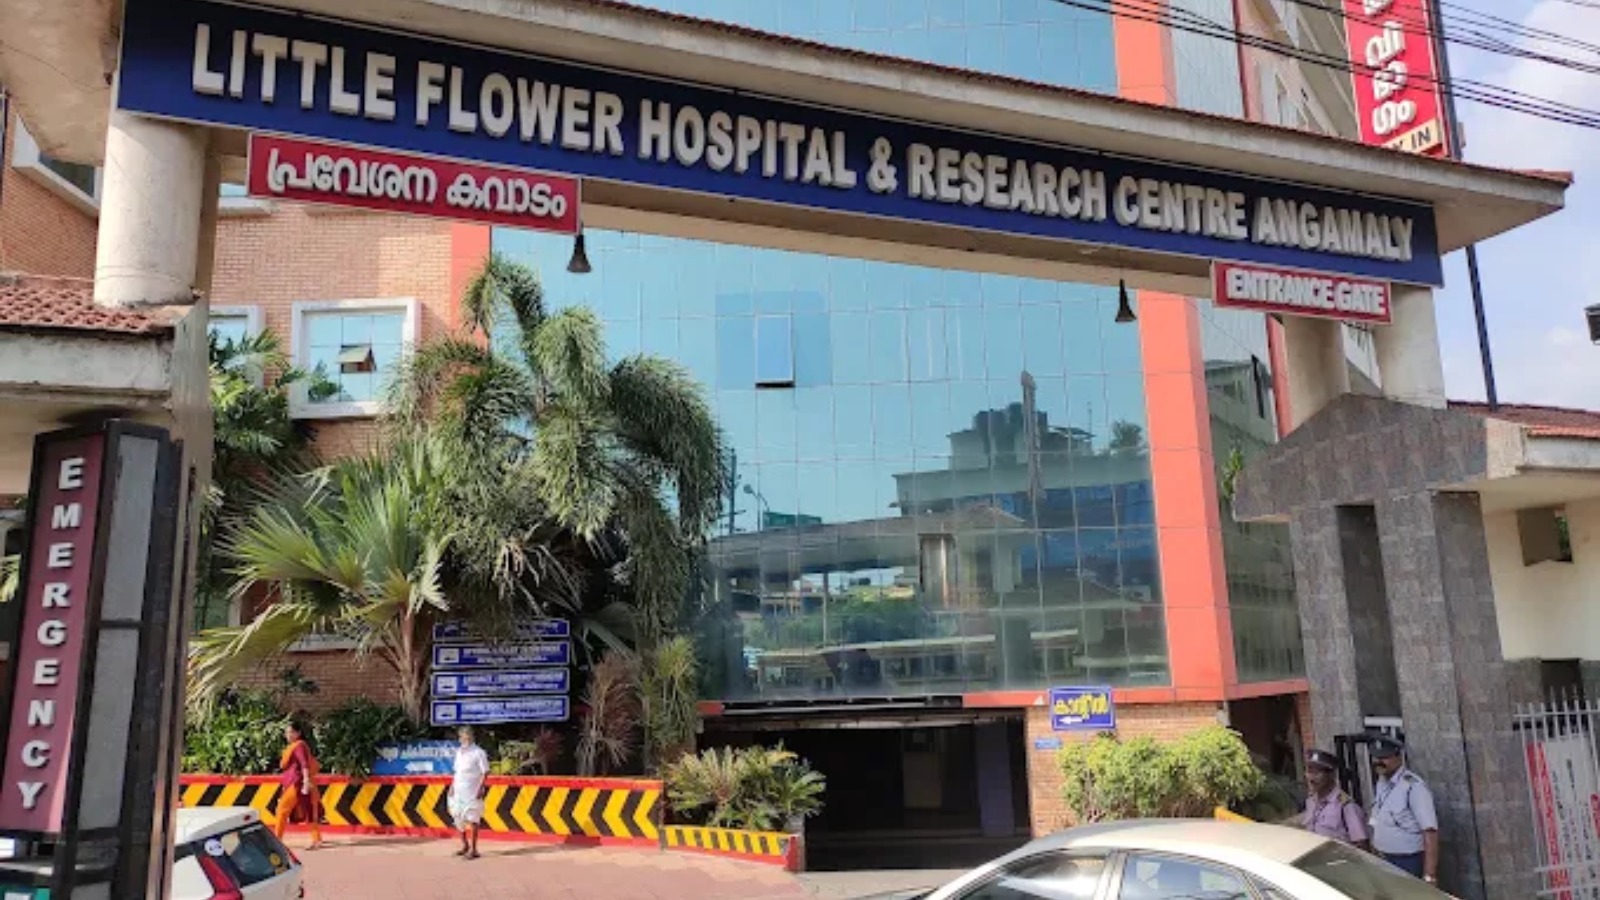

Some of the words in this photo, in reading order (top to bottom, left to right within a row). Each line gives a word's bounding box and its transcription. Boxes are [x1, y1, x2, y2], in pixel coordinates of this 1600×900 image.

[191, 23, 396, 120] LITTLE
[415, 61, 624, 156] FLOWER
[638, 98, 857, 189] HOSPITAL
[867, 136, 898, 194] &
[906, 142, 1107, 221] RESEARCH
[1113, 175, 1248, 241] CENTRE
[1252, 198, 1413, 262] ANGAMALY
[1411, 126, 1432, 149] IN
[267, 148, 437, 204] പ്രവേശന
[446, 173, 567, 218] കവാടം
[1226, 268, 1335, 309] ENTRANCE
[1335, 282, 1387, 316] GATE
[17, 457, 85, 812] EMERGENCY
